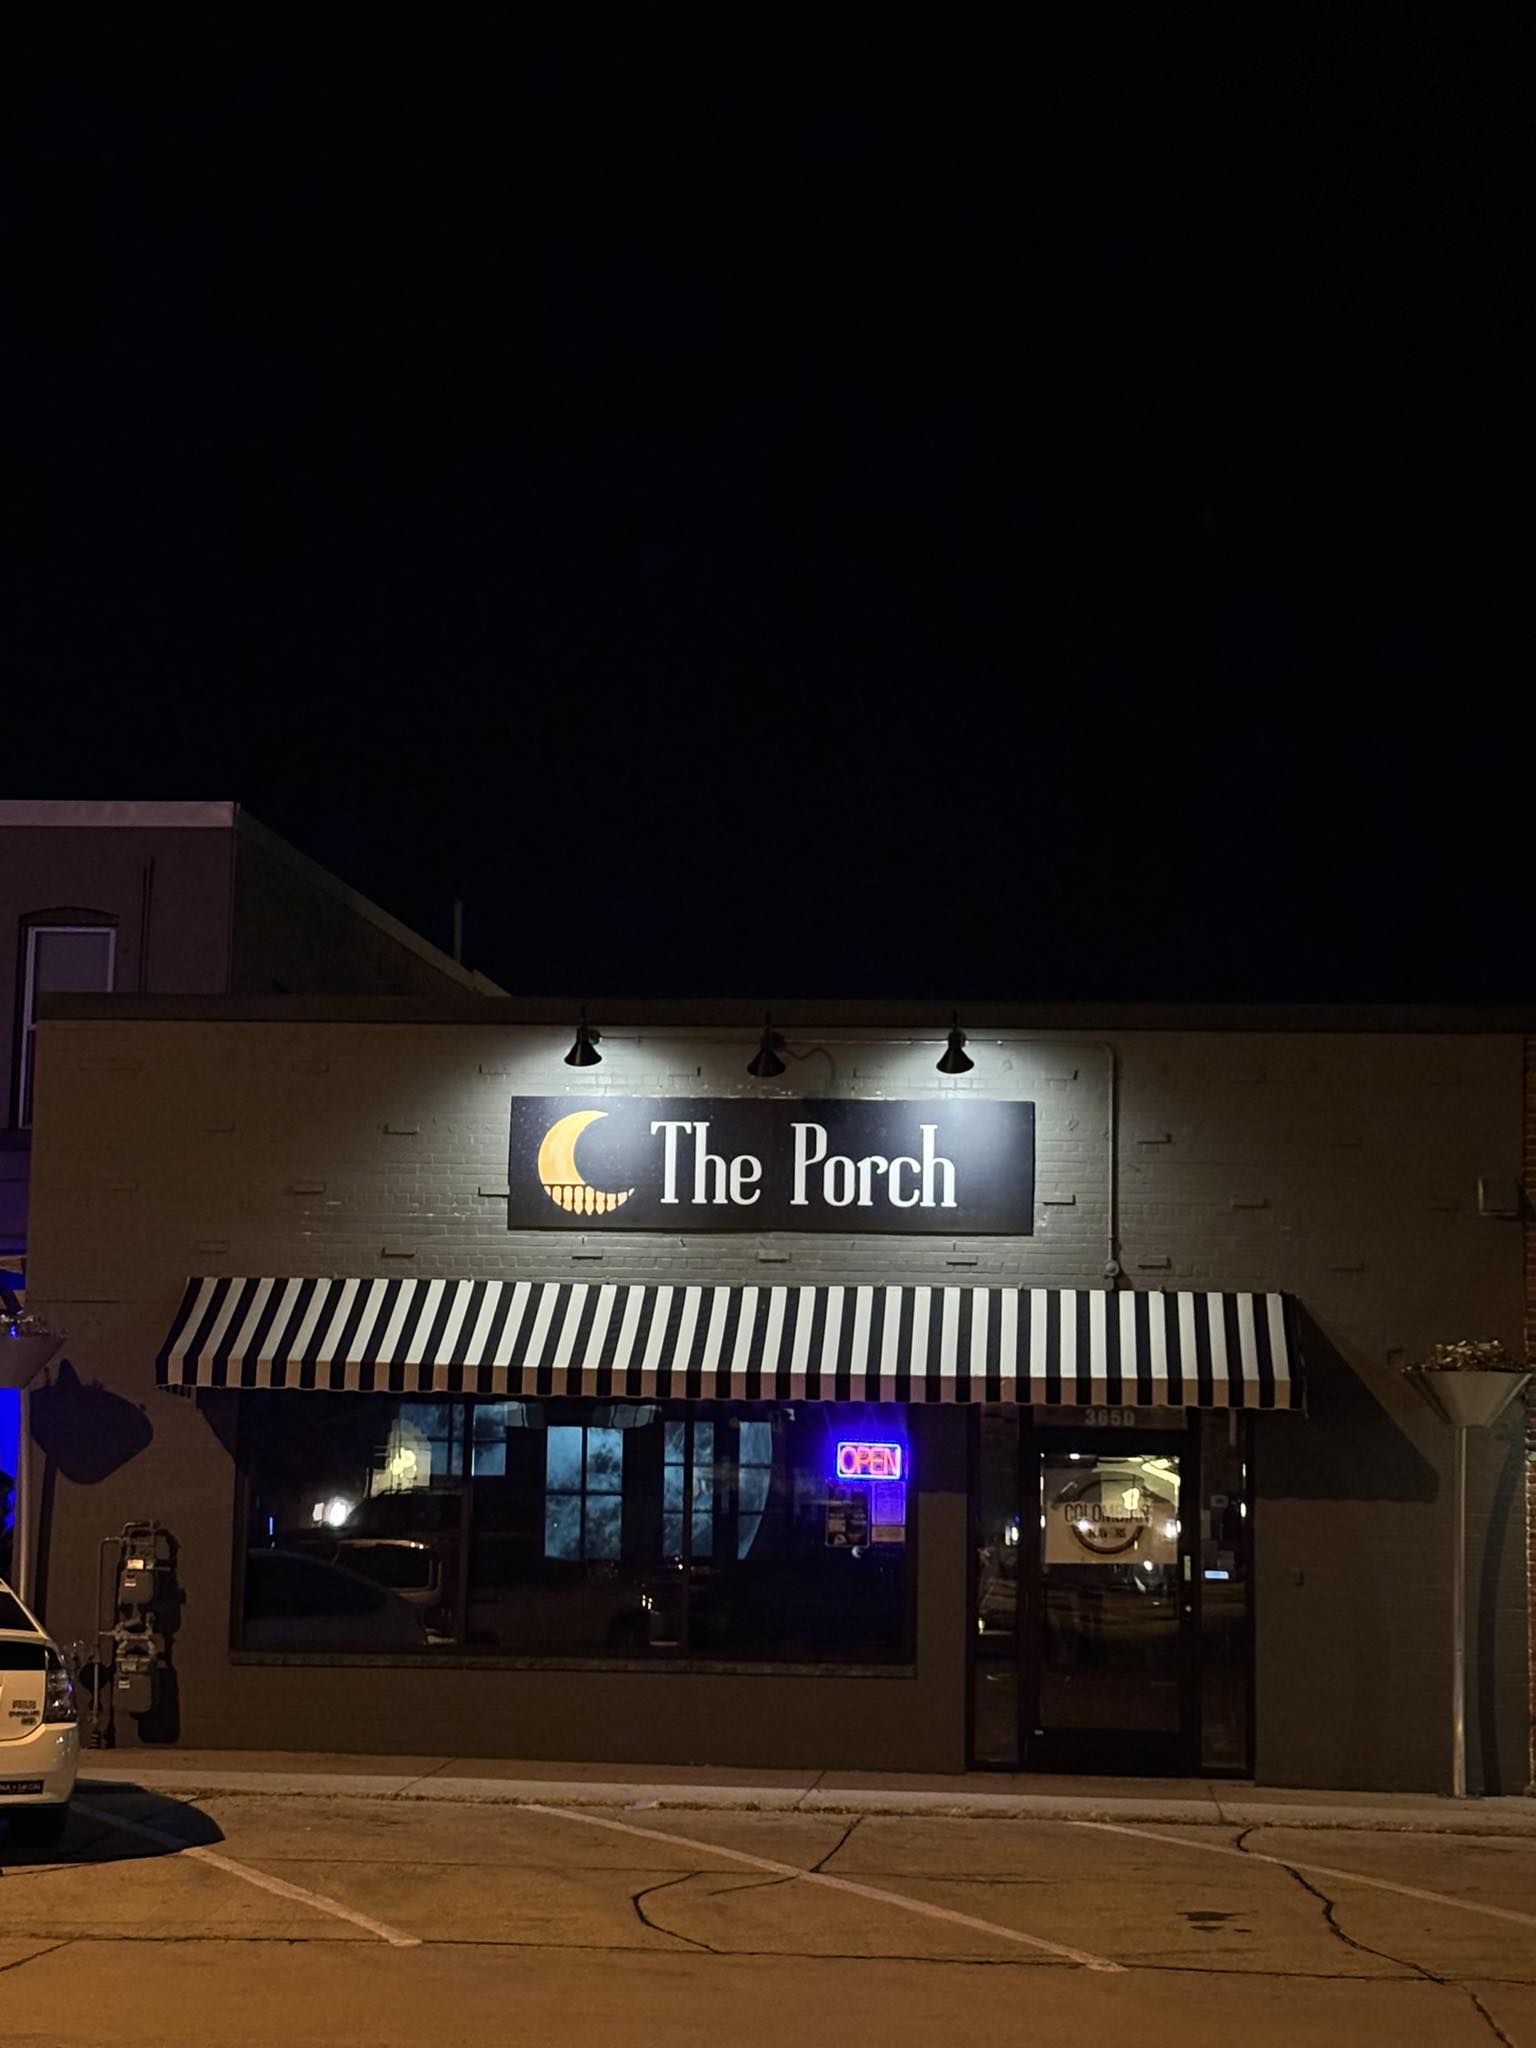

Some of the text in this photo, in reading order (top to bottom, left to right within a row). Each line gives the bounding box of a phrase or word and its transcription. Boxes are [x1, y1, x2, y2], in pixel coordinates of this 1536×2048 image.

[651, 1121, 957, 1207] The Porch
[840, 1446, 900, 1475] OPEN
[1064, 1503, 1150, 1523] COLOMBN
